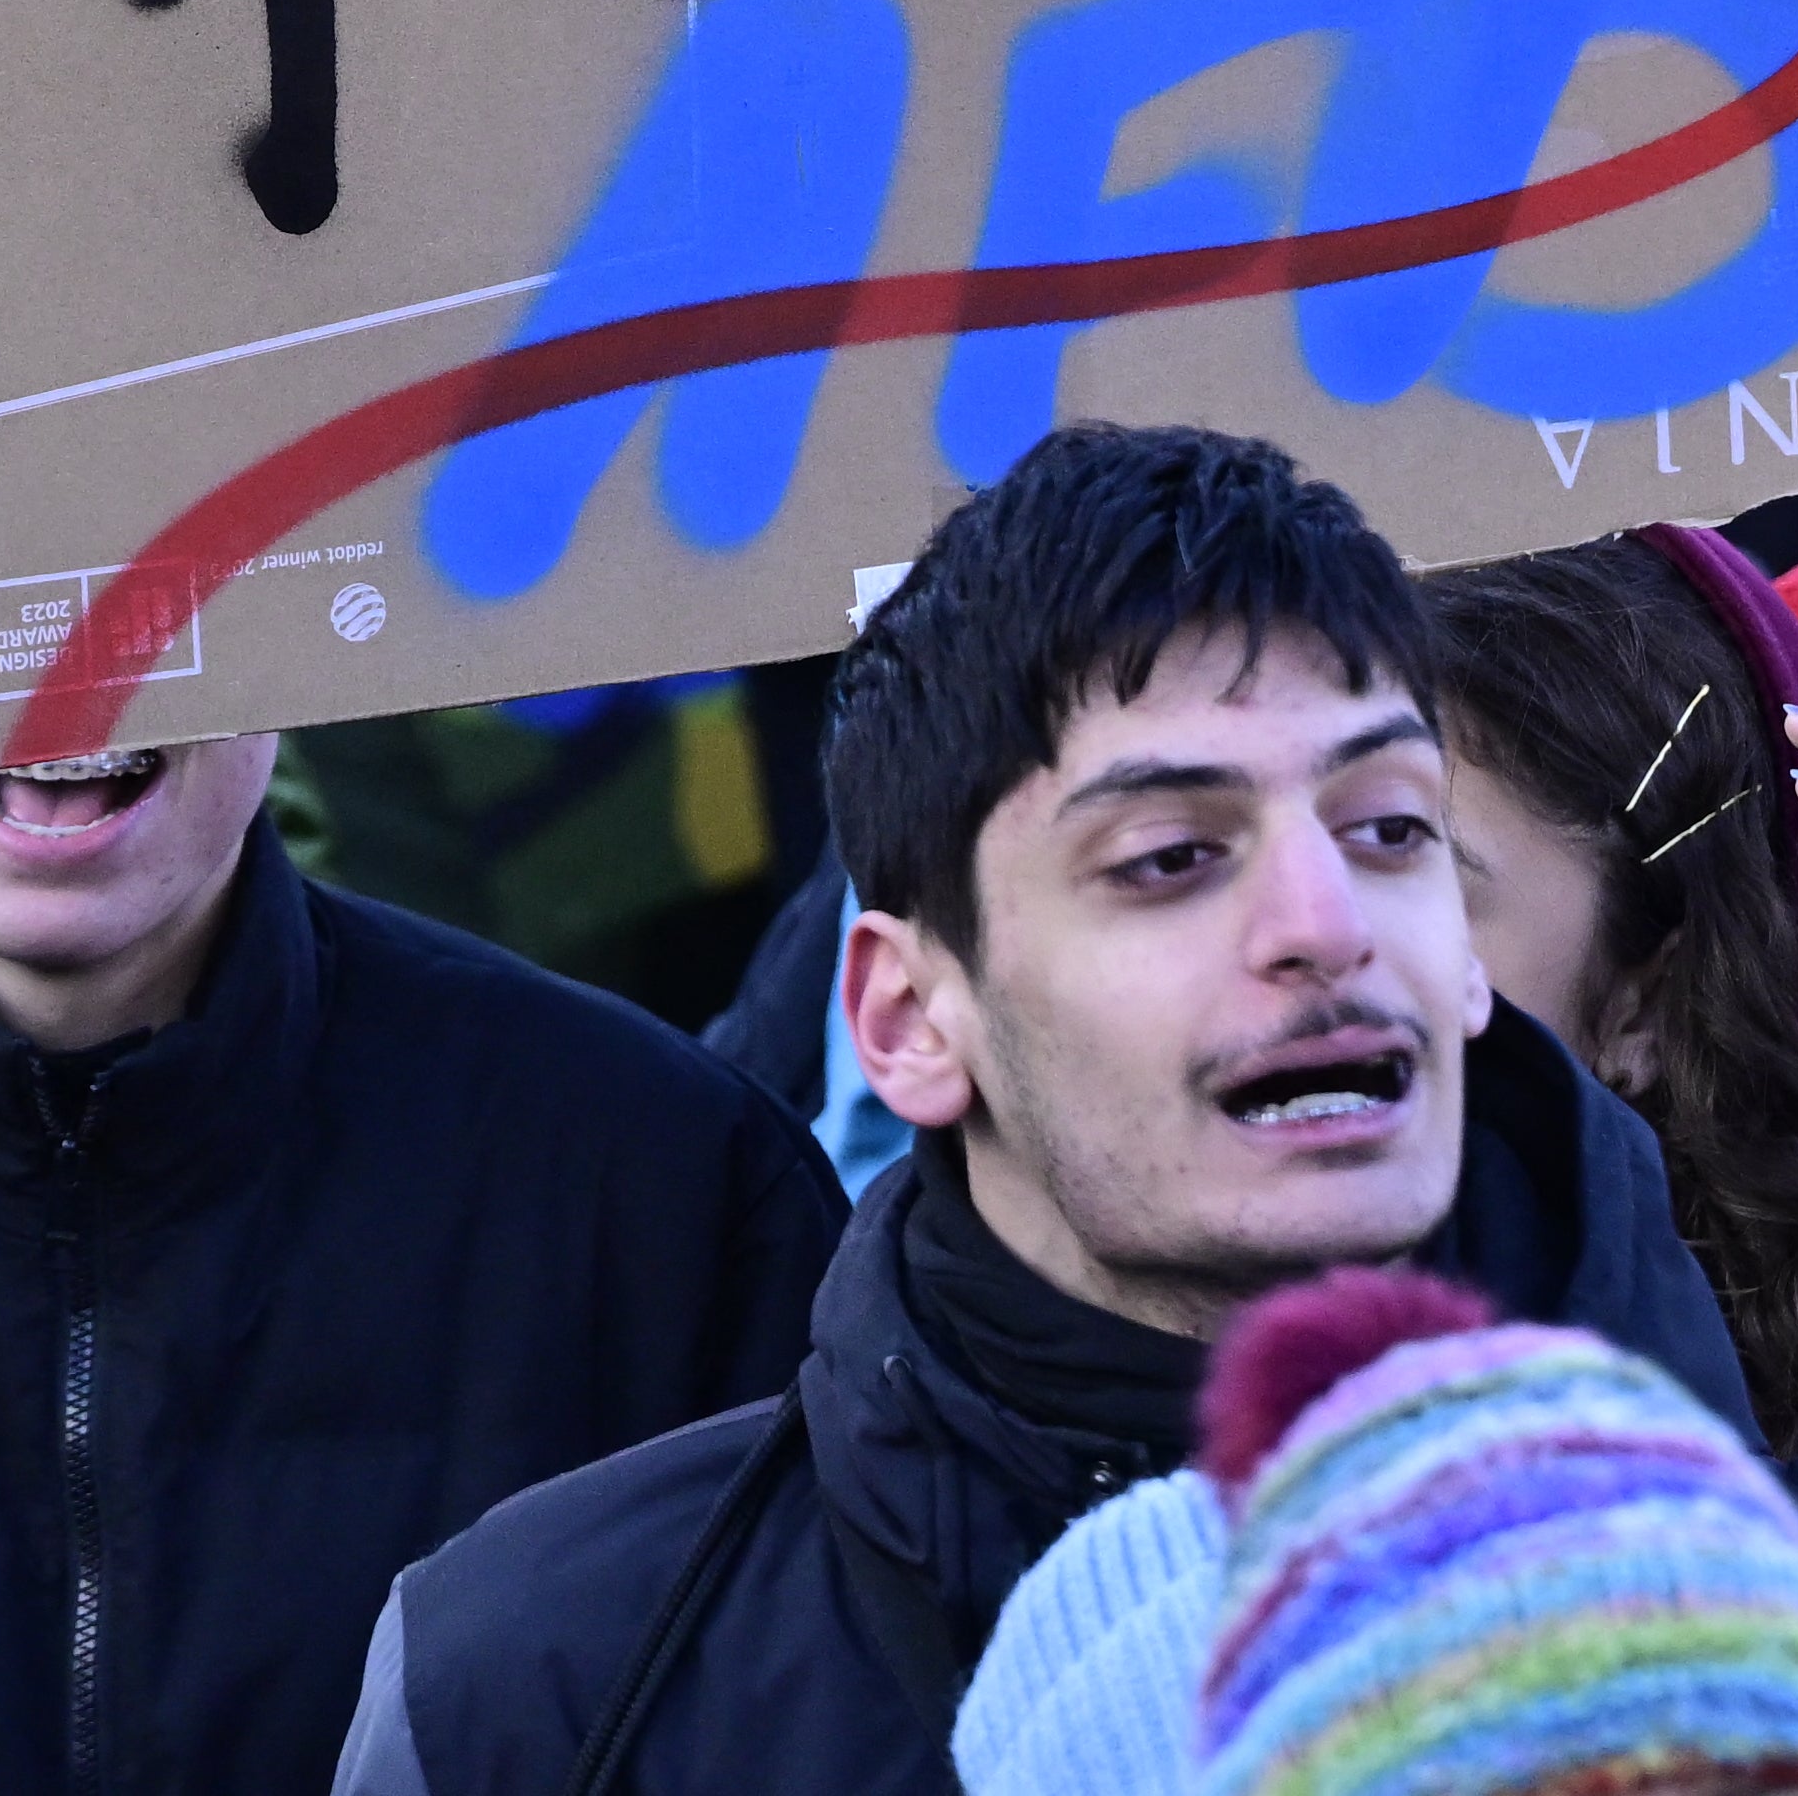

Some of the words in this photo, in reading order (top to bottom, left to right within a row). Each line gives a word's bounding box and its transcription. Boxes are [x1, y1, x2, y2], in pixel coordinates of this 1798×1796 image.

[260, 548, 321, 571] winner
[326, 540, 383, 565] reddot
[20, 598, 72, 623] 2023
